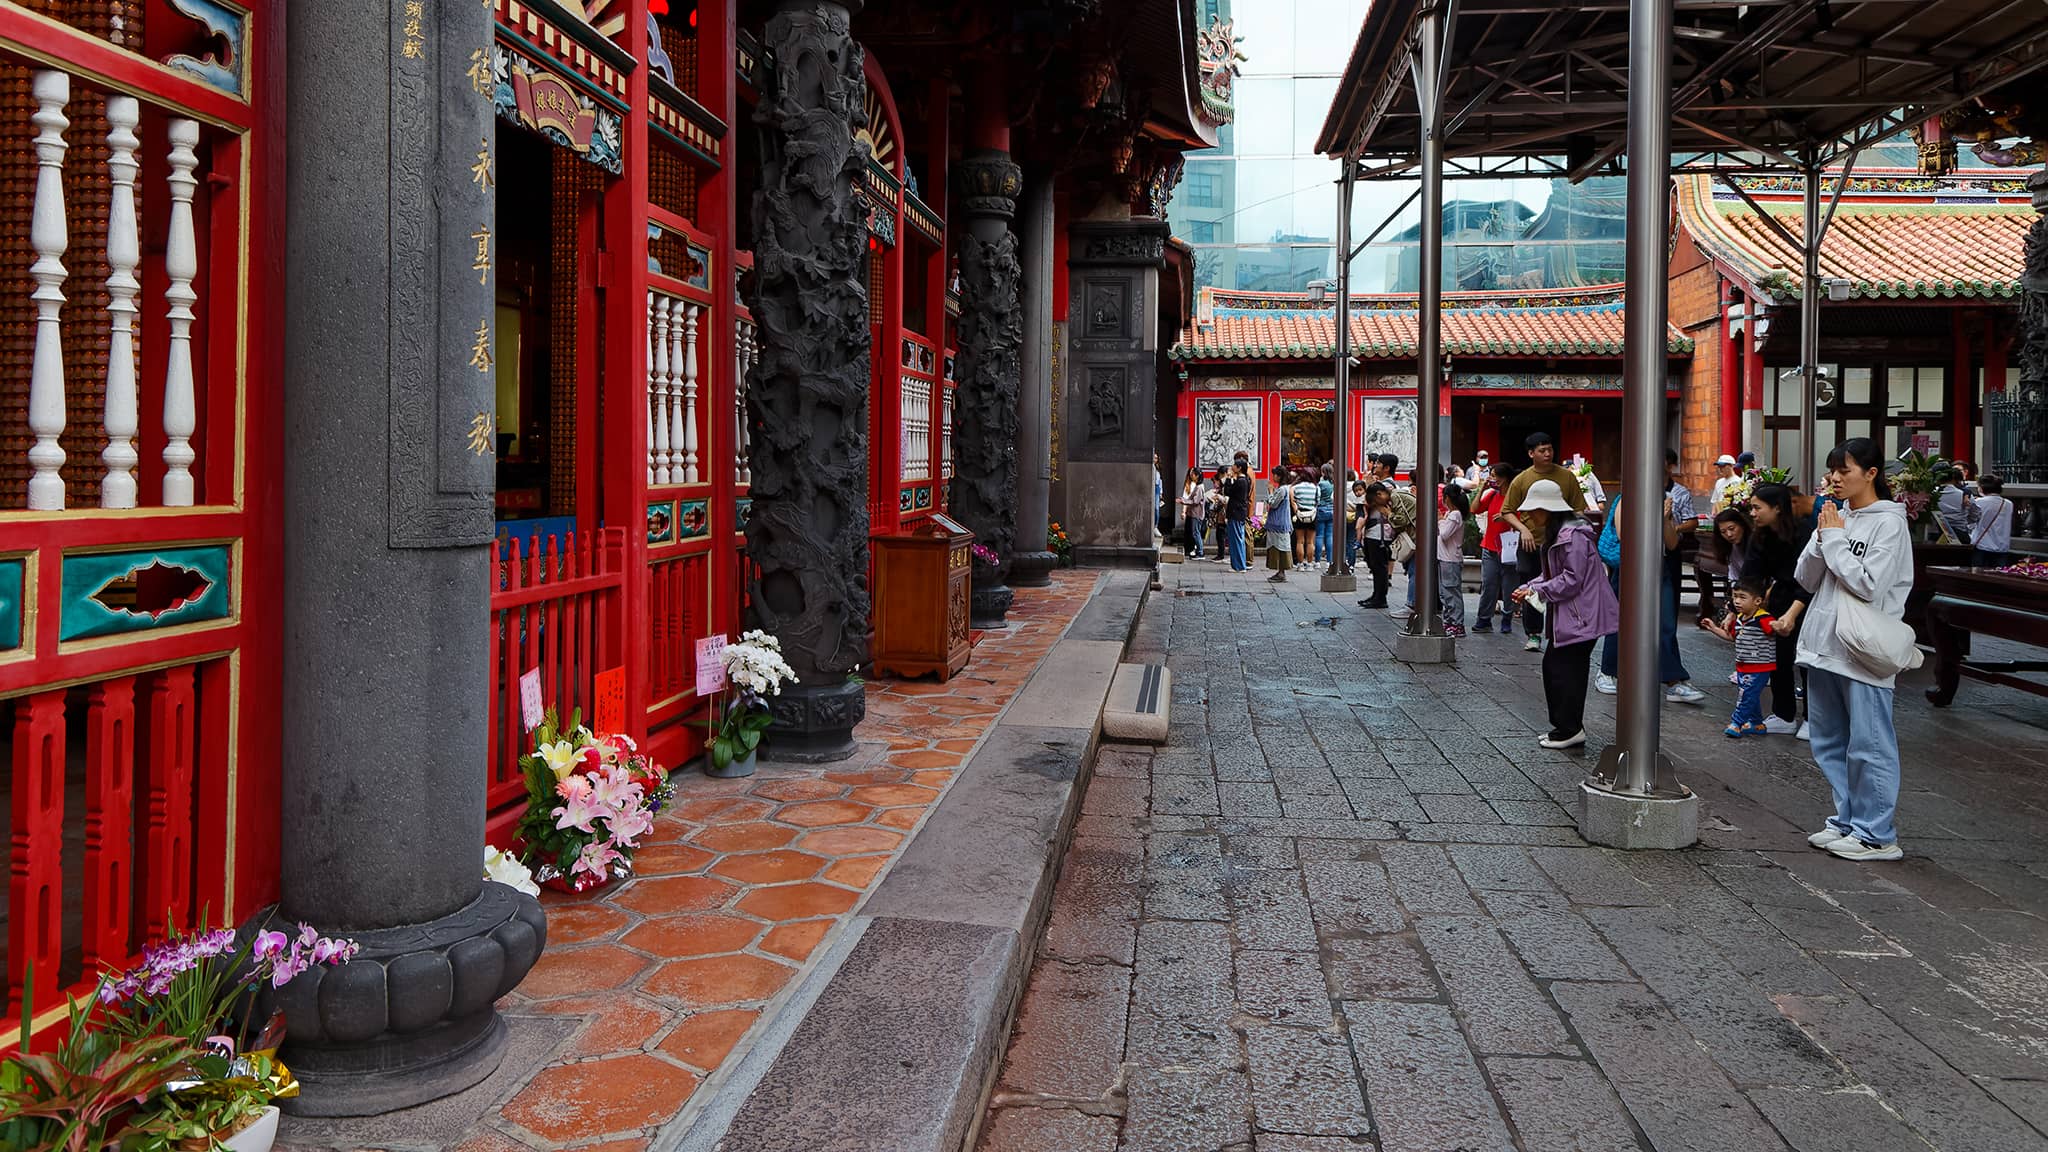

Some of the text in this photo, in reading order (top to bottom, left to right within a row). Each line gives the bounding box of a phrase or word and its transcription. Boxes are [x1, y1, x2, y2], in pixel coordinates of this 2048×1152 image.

[466, 0, 495, 456] 德永享春秋
